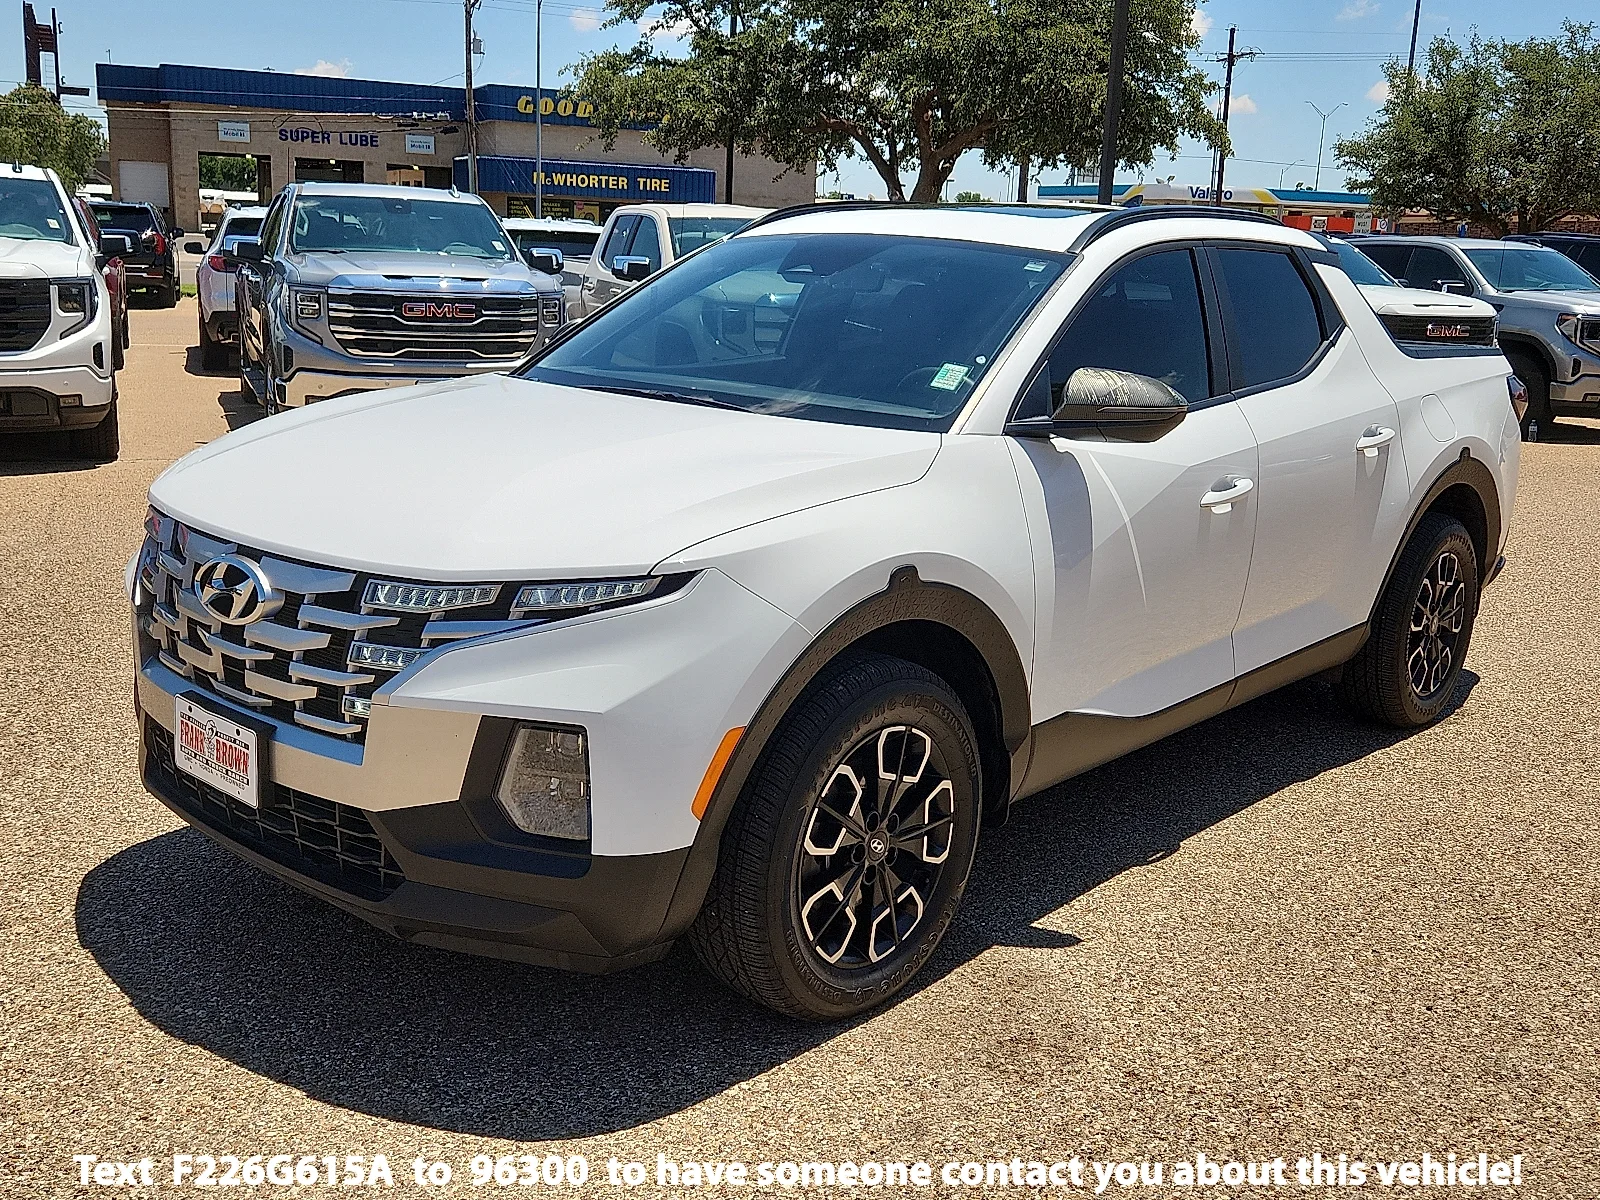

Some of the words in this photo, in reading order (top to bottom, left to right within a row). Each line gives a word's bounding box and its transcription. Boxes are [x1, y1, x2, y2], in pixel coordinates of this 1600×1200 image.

[278, 128, 331, 147] SUPER
[339, 132, 379, 148] LUBE
[533, 171, 628, 190] McWHORTER
[637, 177, 670, 192] TIRE
[402, 302, 476, 318] GMC
[1426, 324, 1471, 337] GMC
[180, 719, 206, 756] FRANK
[215, 739, 249, 776] BROWN
